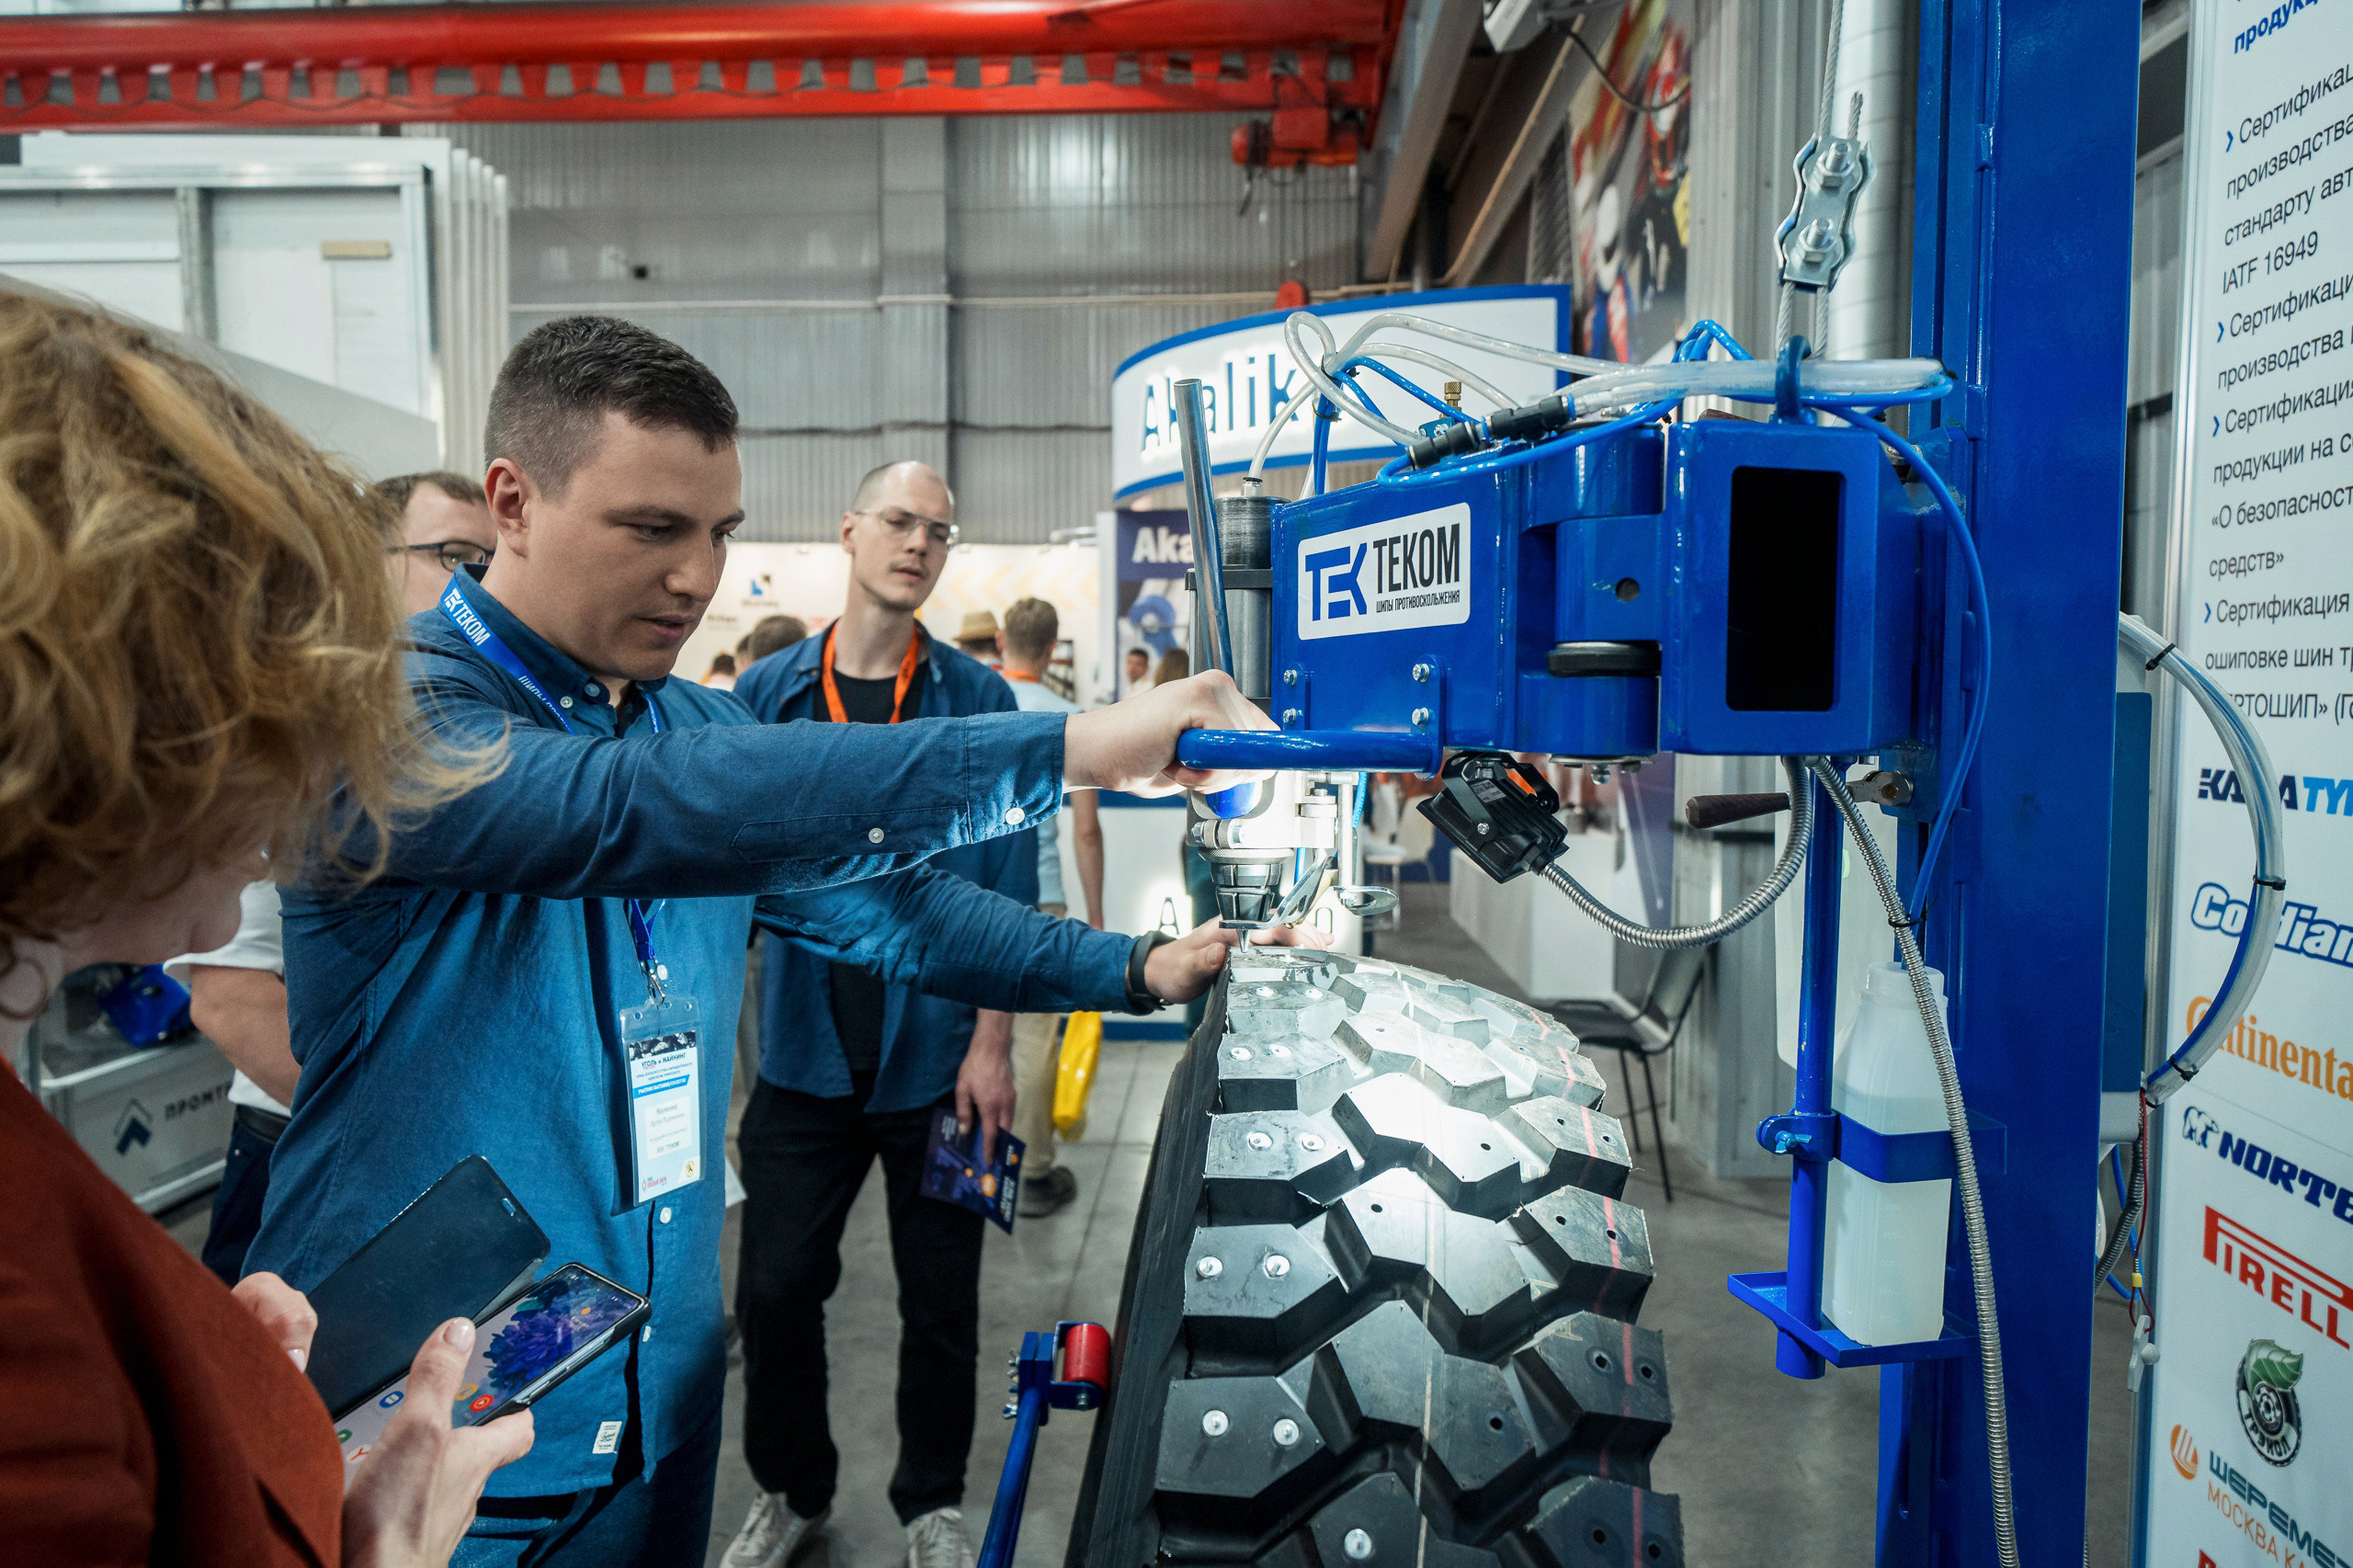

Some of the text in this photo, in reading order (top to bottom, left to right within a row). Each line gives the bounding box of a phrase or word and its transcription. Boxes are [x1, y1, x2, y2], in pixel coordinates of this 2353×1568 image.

[2224, 186, 2315, 246] стандарту
[2222, 231, 2318, 294] IATF 16949
[2218, 329, 2344, 392] производства
[2213, 445, 2304, 487] продукции
[2311, 437, 2333, 460] на
[2211, 505, 2232, 528] «О
[1373, 522, 1461, 595] ТЕКОМ
[2209, 551, 2284, 582] средств»
[1376, 589, 1461, 613] ШИПЫ ПРОТИВОСКОЛЬЖЕНИЯ
[2217, 593, 2350, 627] Сертификация
[452, 603, 491, 646] ТЕКОМ
[2206, 649, 2288, 670] ошиповке
[2294, 647, 2333, 667] шин
[2208, 1480, 2279, 1563] МОСКВА
